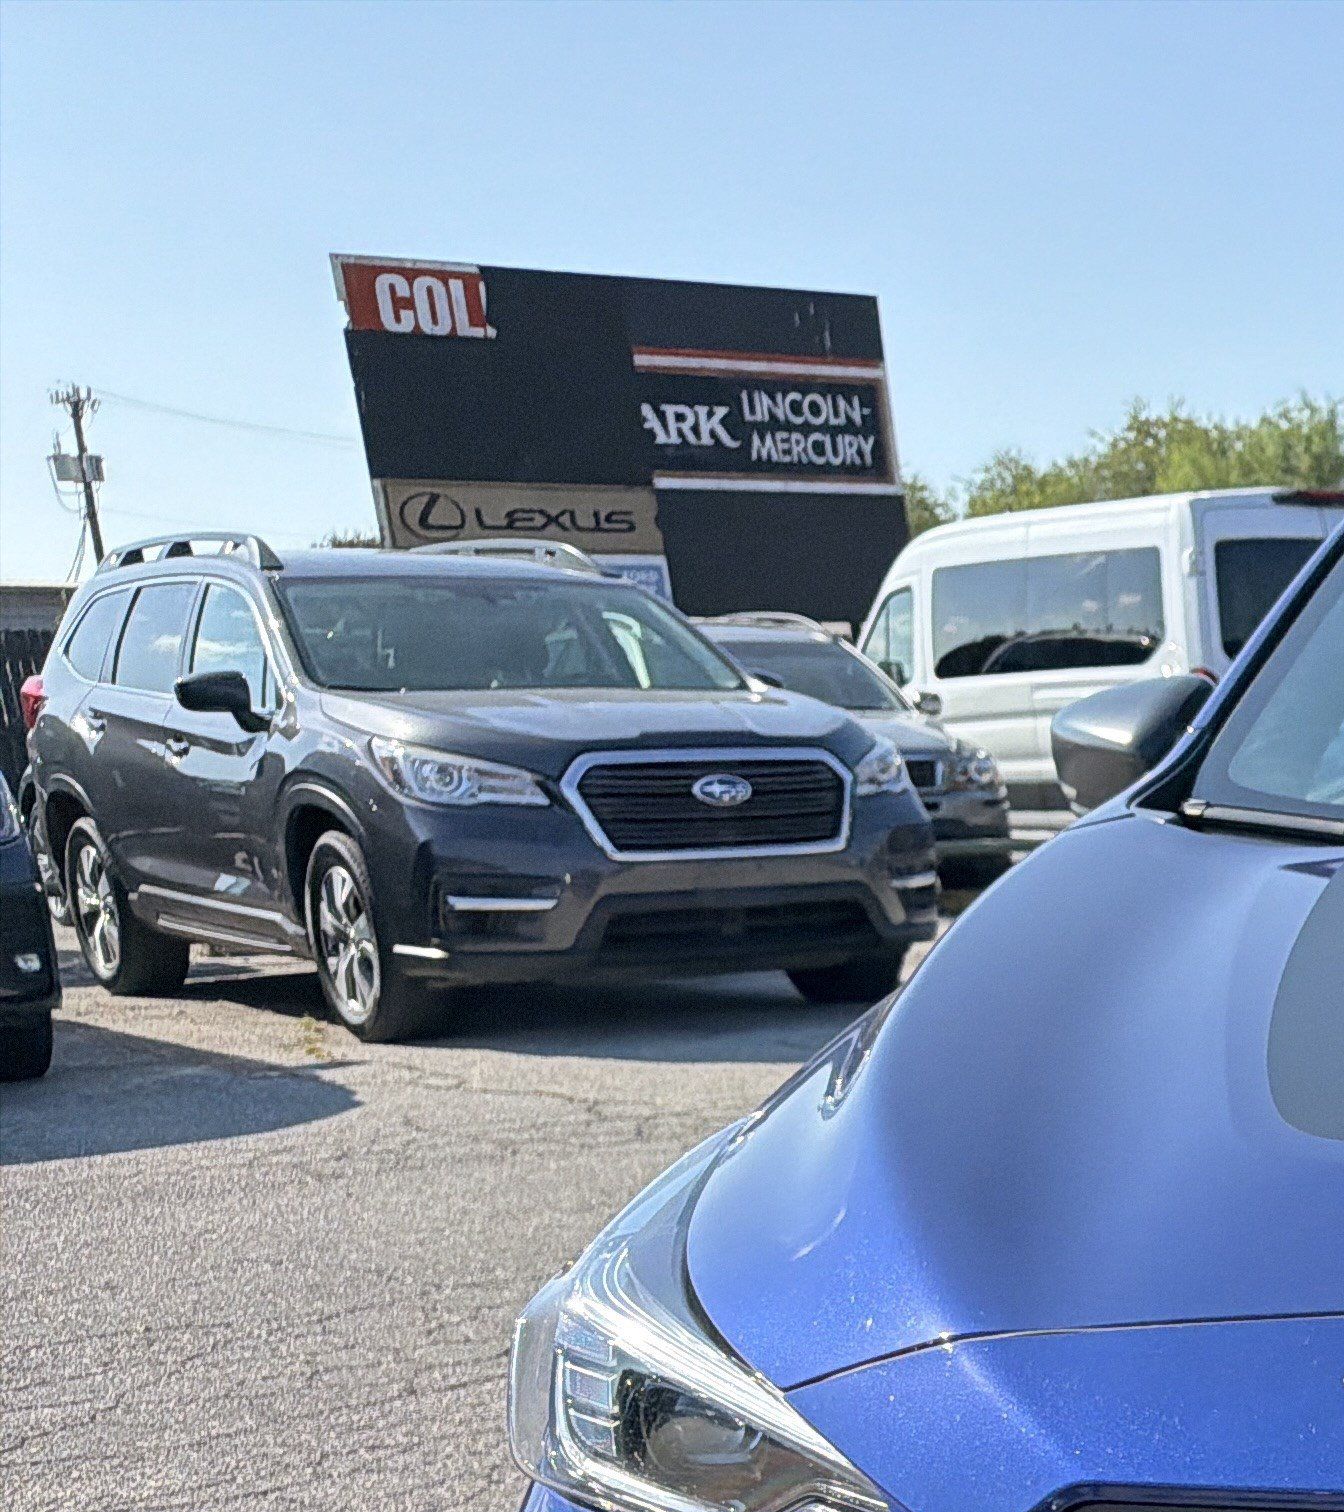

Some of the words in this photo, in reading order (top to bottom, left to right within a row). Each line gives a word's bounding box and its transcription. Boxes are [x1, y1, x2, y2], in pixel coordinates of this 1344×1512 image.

[740, 389, 872, 428] LINCOLN-
[751, 429, 875, 467] MERCURY
[475, 506, 637, 533] LEXUS
